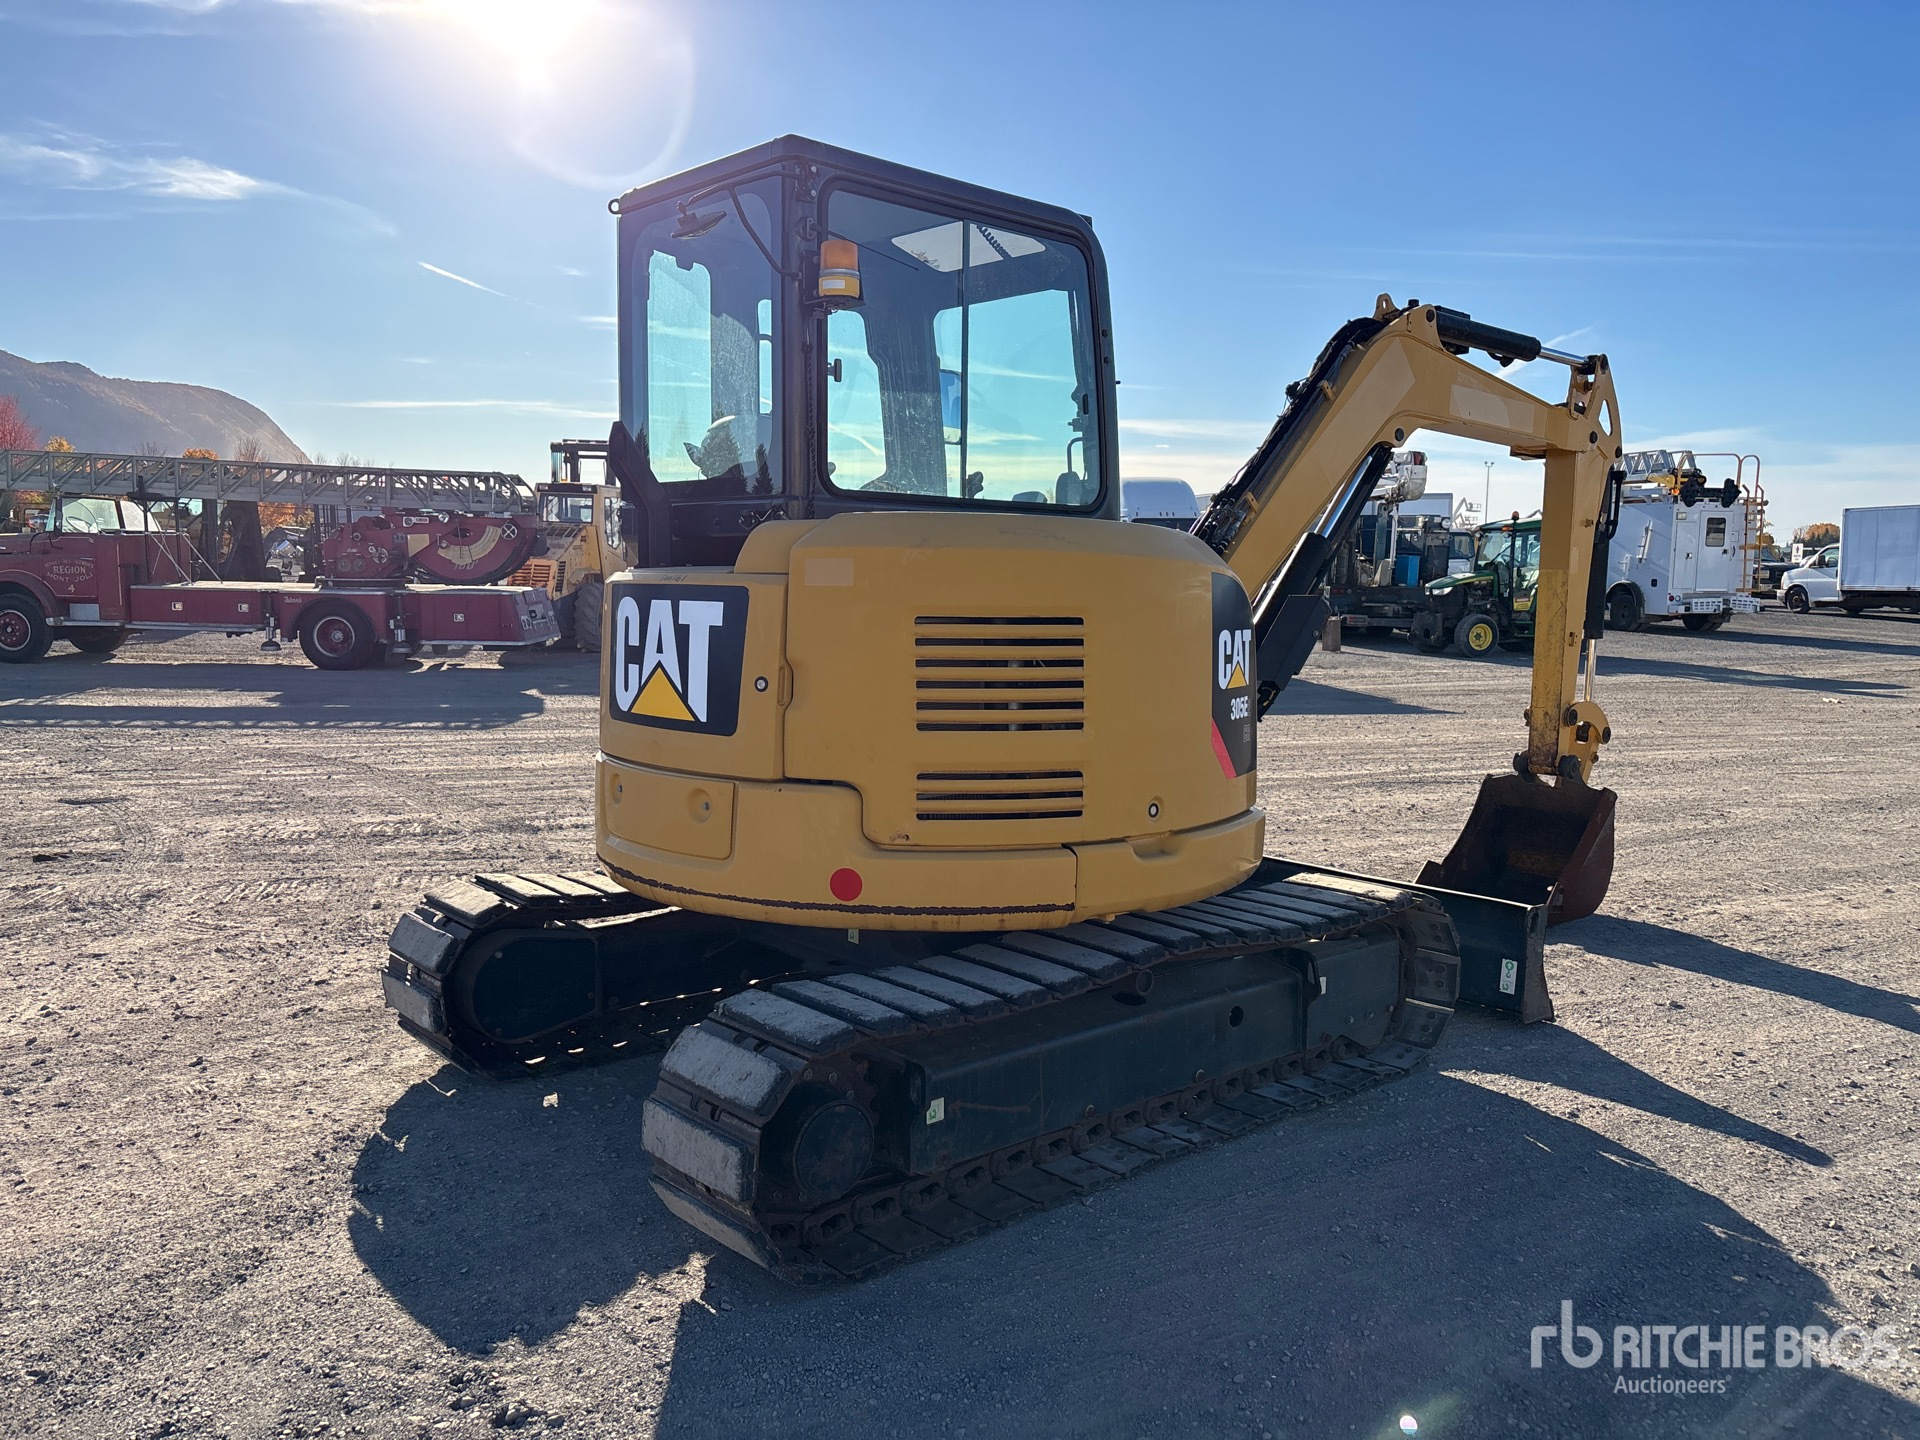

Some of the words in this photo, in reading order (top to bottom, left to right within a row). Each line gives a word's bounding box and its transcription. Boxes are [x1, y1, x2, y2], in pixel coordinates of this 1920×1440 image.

[53, 565, 86, 574] REGION
[47, 572, 69, 582] MONT
[74, 572, 93, 582] JOLI
[67, 584, 75, 593] 4
[615, 596, 724, 722] CAT
[1218, 629, 1251, 689] CAT
